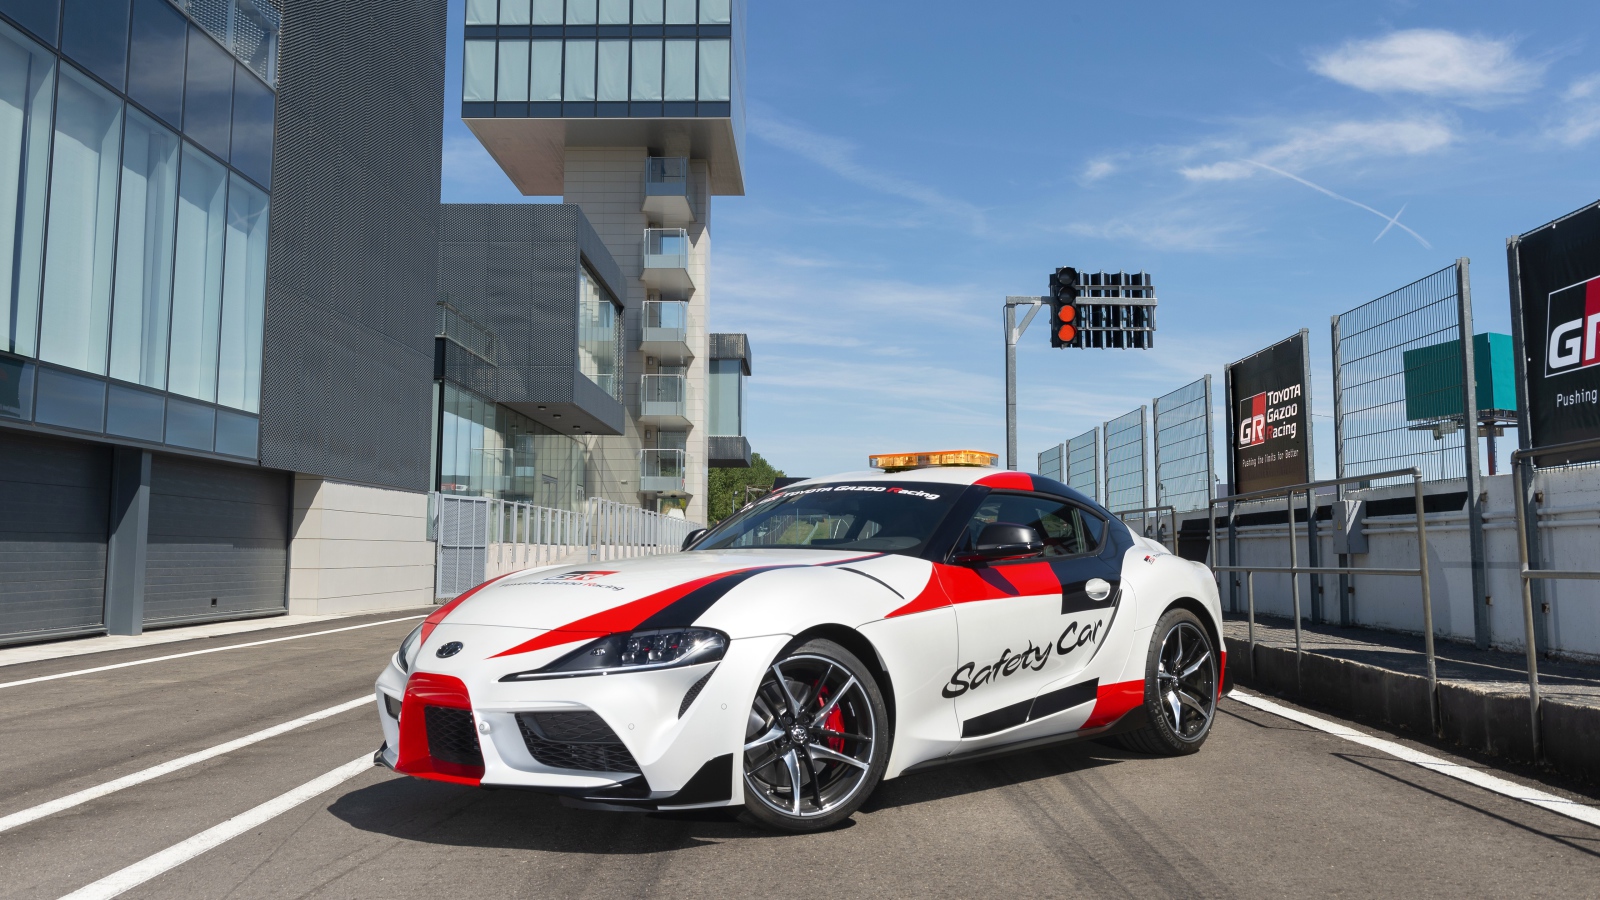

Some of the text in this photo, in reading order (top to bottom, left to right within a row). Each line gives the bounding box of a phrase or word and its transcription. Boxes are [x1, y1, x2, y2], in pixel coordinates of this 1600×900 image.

[1267, 384, 1301, 406] TOYOTA
[1556, 388, 1598, 408] Pushing
[1266, 403, 1298, 423] GAZOO
[1240, 413, 1265, 445] GR
[1266, 421, 1297, 439] Racing
[783, 486, 834, 498] TOYOTA
[886, 486, 941, 501] Racing
[941, 619, 1103, 699] Safety Car
